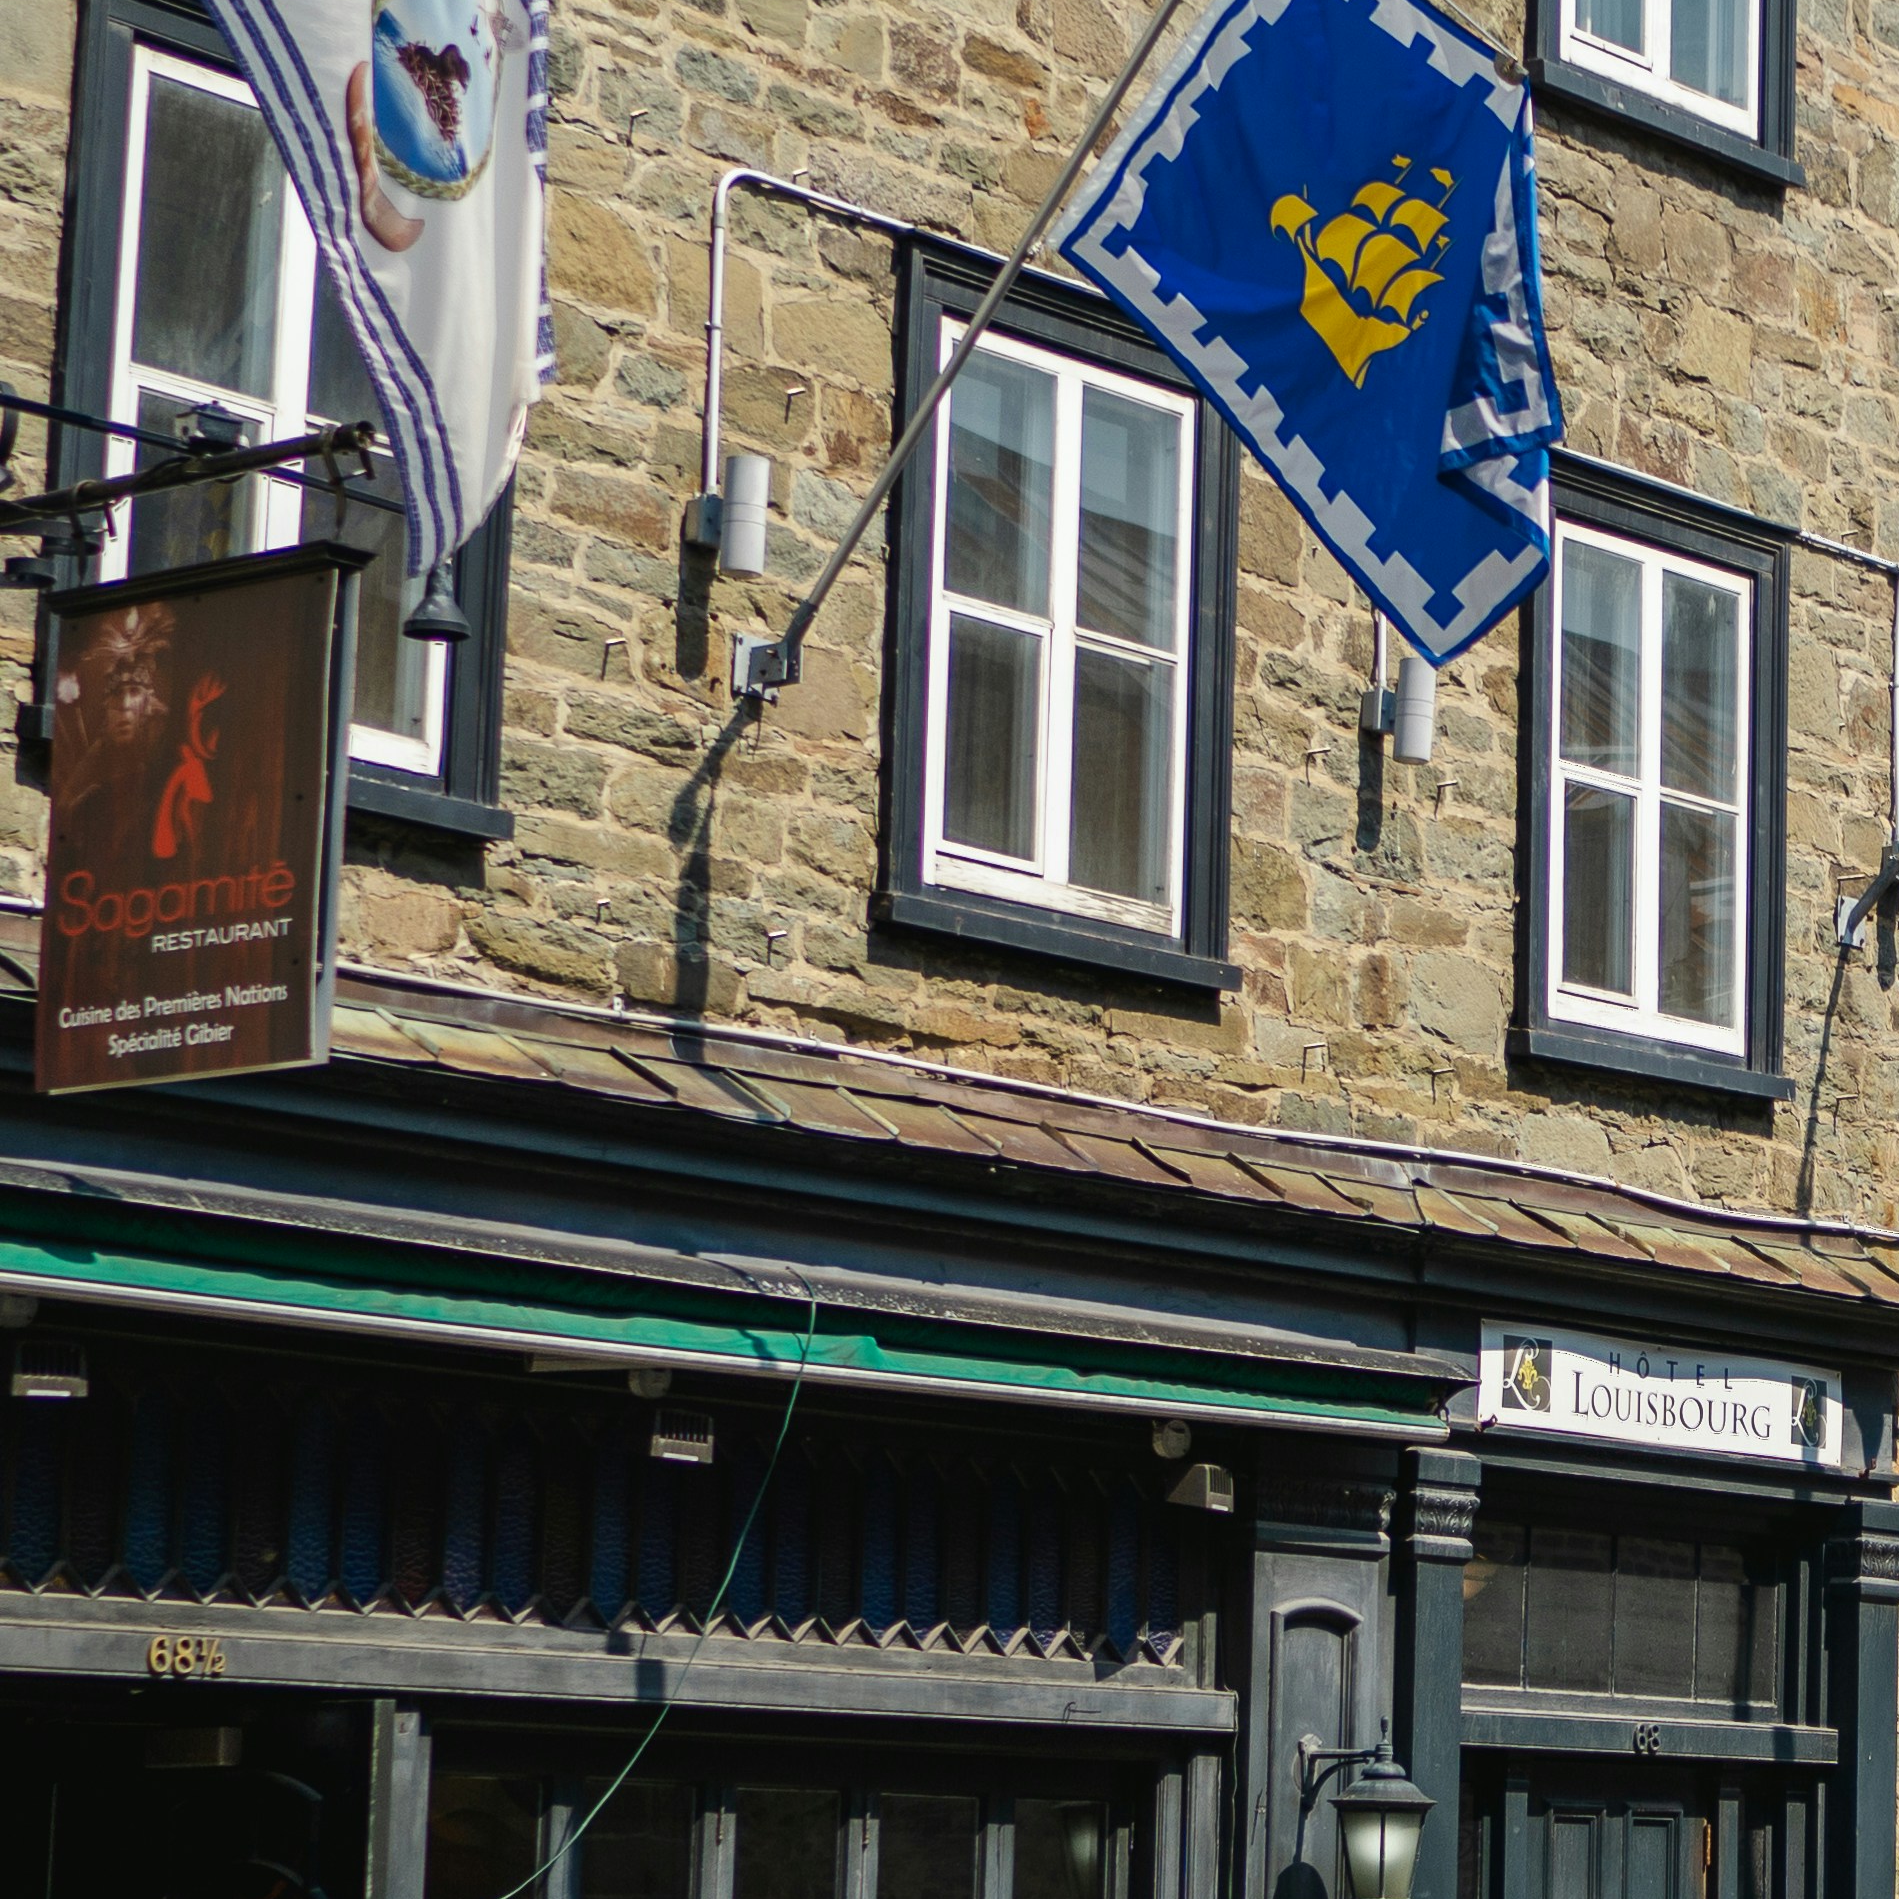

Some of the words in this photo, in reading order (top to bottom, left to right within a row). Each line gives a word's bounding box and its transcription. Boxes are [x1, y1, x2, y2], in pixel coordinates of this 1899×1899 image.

[151, 917, 294, 953] RESTAURANT
[58, 1005, 113, 1029] Cuisine
[115, 1000, 142, 1022] des
[144, 990, 223, 1018] Premières
[225, 983, 289, 1008] Nations
[107, 1026, 183, 1059] Spécialité
[185, 1022, 235, 1046] Gibier
[1610, 1351, 1733, 1391] HÔTEL
[1572, 1369, 1772, 1441] LOUISBOURG
